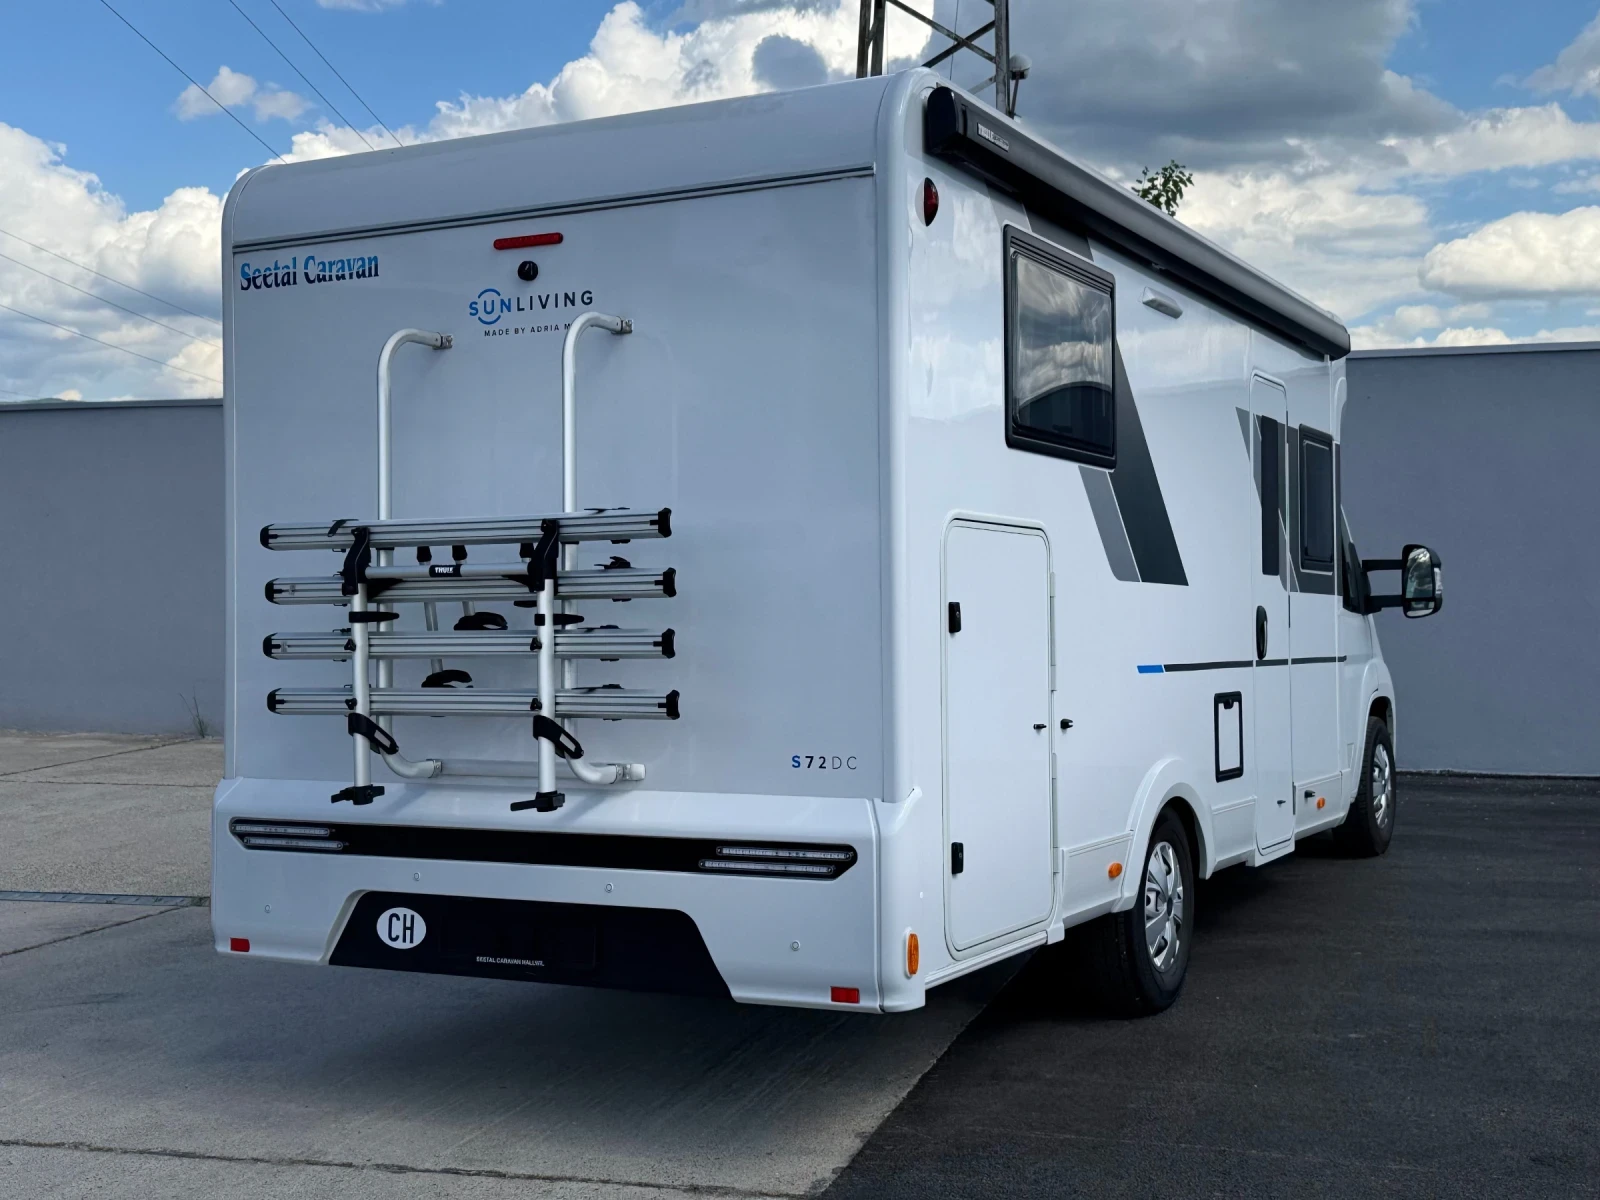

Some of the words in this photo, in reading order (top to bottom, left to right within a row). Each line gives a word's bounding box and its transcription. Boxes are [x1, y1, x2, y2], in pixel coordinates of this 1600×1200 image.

[240, 256, 297, 290] Seetal
[303, 255, 379, 284] Caravan
[469, 289, 593, 317] SUNLIVING
[484, 328, 510, 337] MADE
[514, 327, 525, 335] BY
[530, 324, 560, 333] ADRIA
[388, 912, 415, 944] CH
[496, 957, 522, 965] CARAVAN
